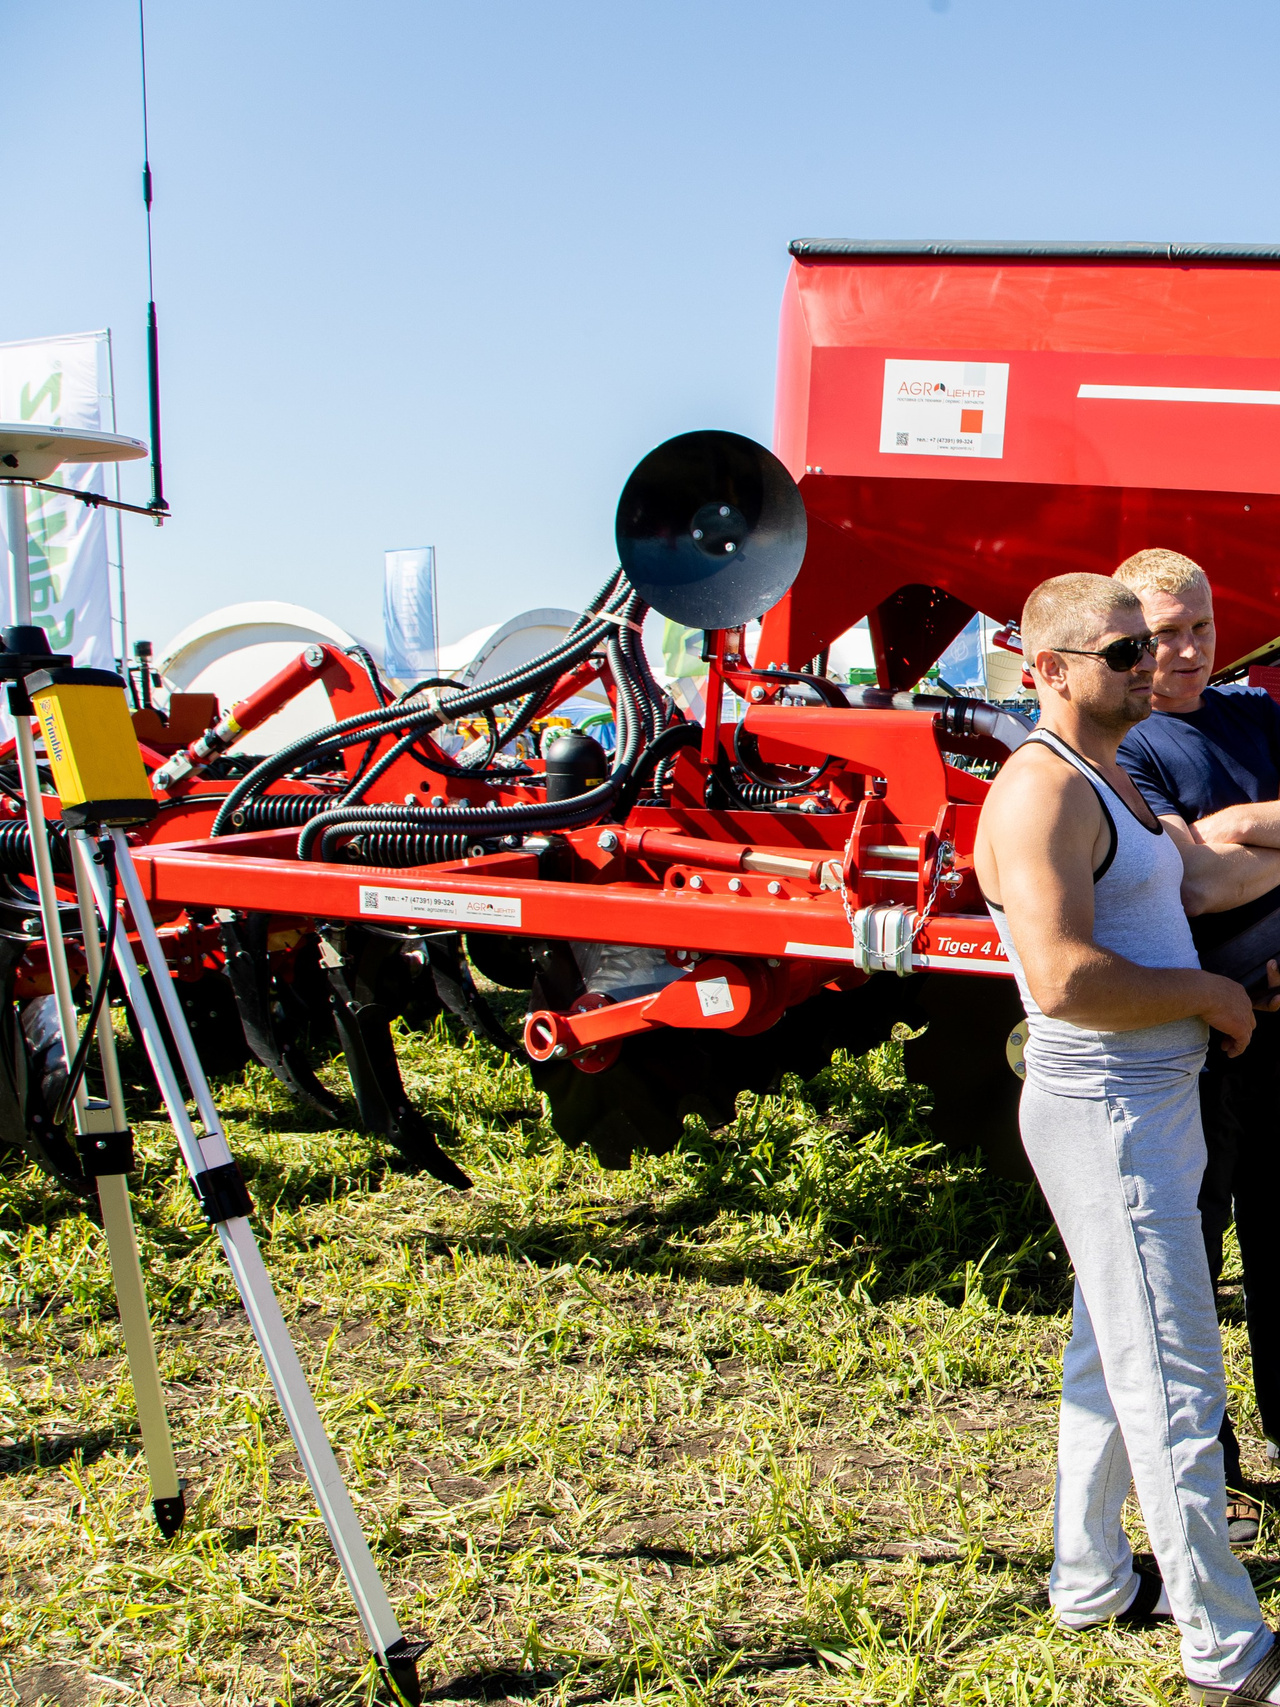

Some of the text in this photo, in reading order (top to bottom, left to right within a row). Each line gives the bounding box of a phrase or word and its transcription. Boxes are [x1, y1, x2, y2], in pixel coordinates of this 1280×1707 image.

[44, 713, 63, 762] Trimble
[409, 896, 433, 905] (47391)
[433, 898, 455, 906] 99-324
[937, 937, 978, 955] Tiger
[980, 941, 992, 955] 4
